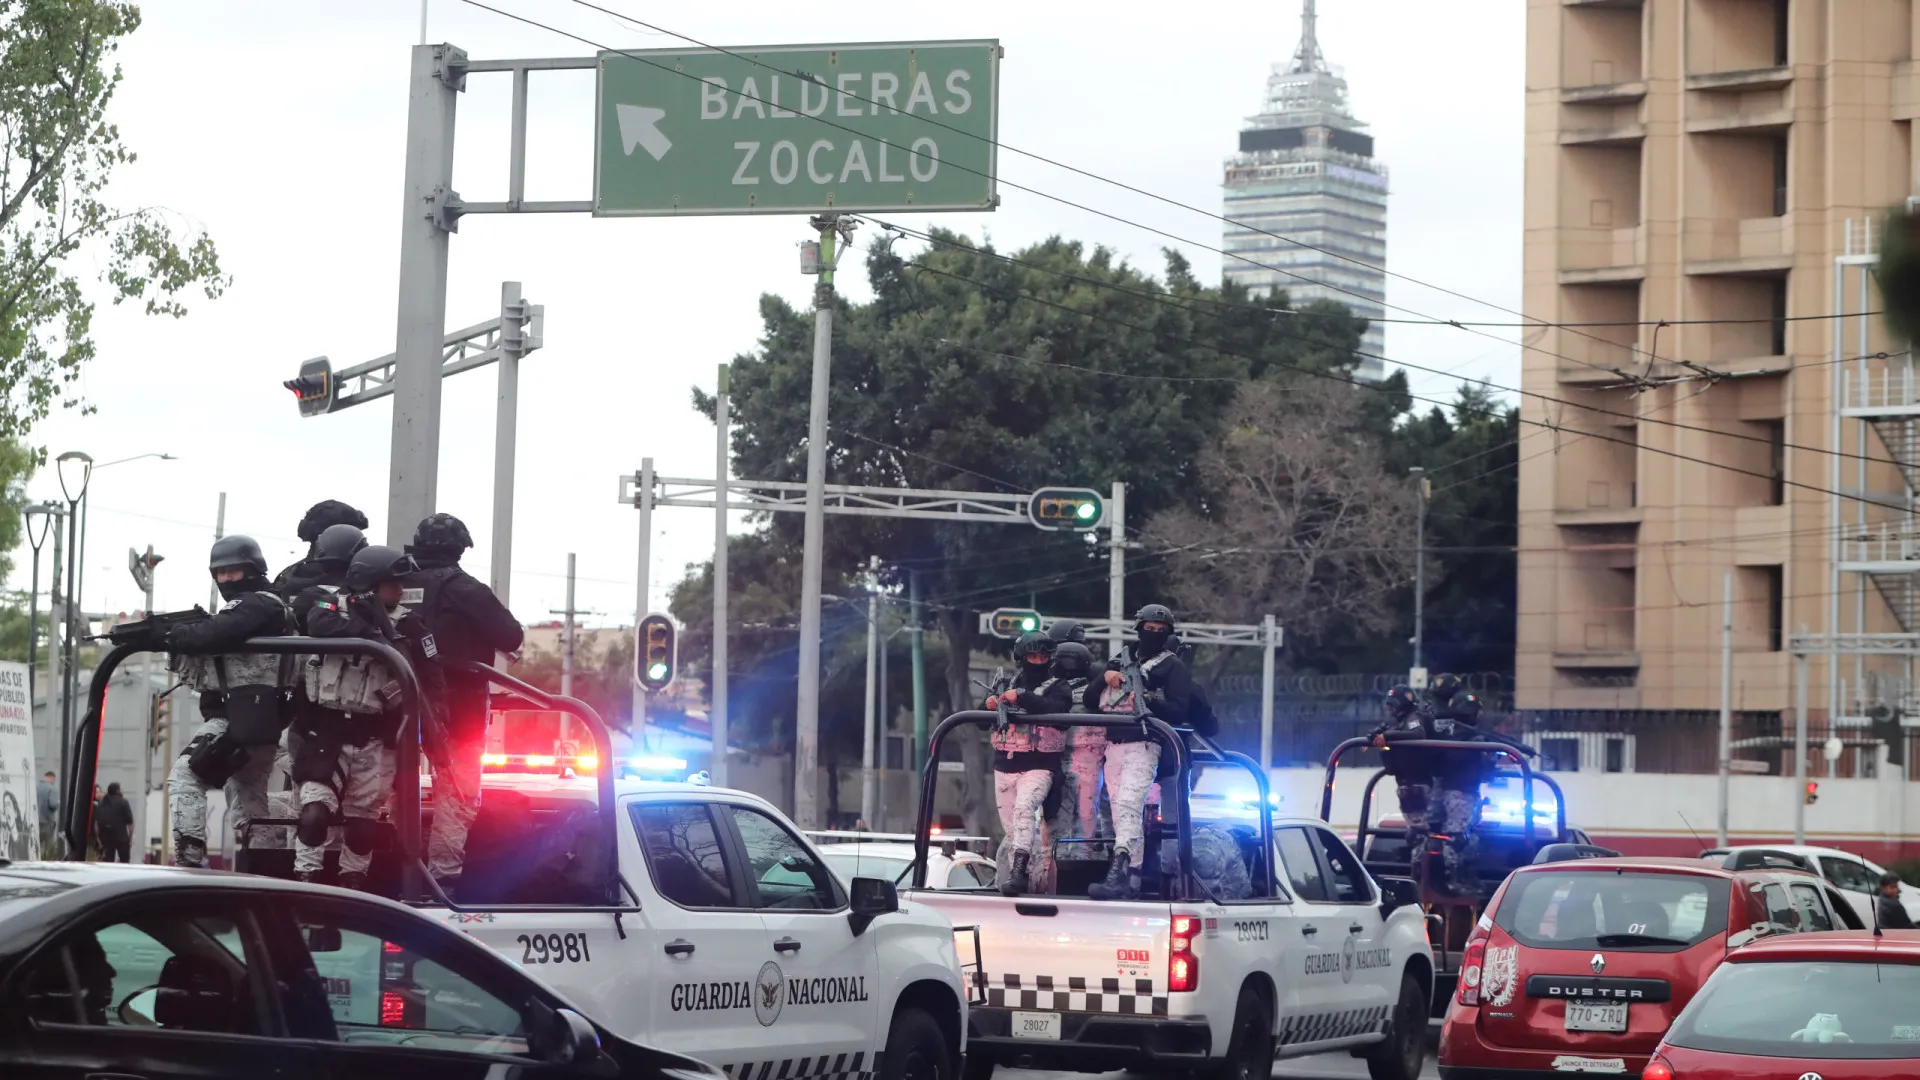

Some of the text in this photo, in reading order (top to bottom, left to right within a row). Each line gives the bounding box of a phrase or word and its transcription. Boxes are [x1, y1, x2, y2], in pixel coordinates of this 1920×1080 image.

[700, 69, 972, 120] BALDERAS
[731, 137, 940, 185] ZOCALO
[13, 672, 22, 687] DE
[1234, 921, 1269, 941] 28027
[1627, 923, 1647, 935] 01
[517, 933, 590, 964] 29981
[1118, 950, 1148, 961] 911
[1305, 948, 1391, 975] GUARDIA NACIONAL
[671, 982, 751, 1011] GUARDIA
[788, 976, 868, 1005] NACIONAL
[1549, 987, 1642, 997] DUSTER
[1023, 1019, 1049, 1031] 28027
